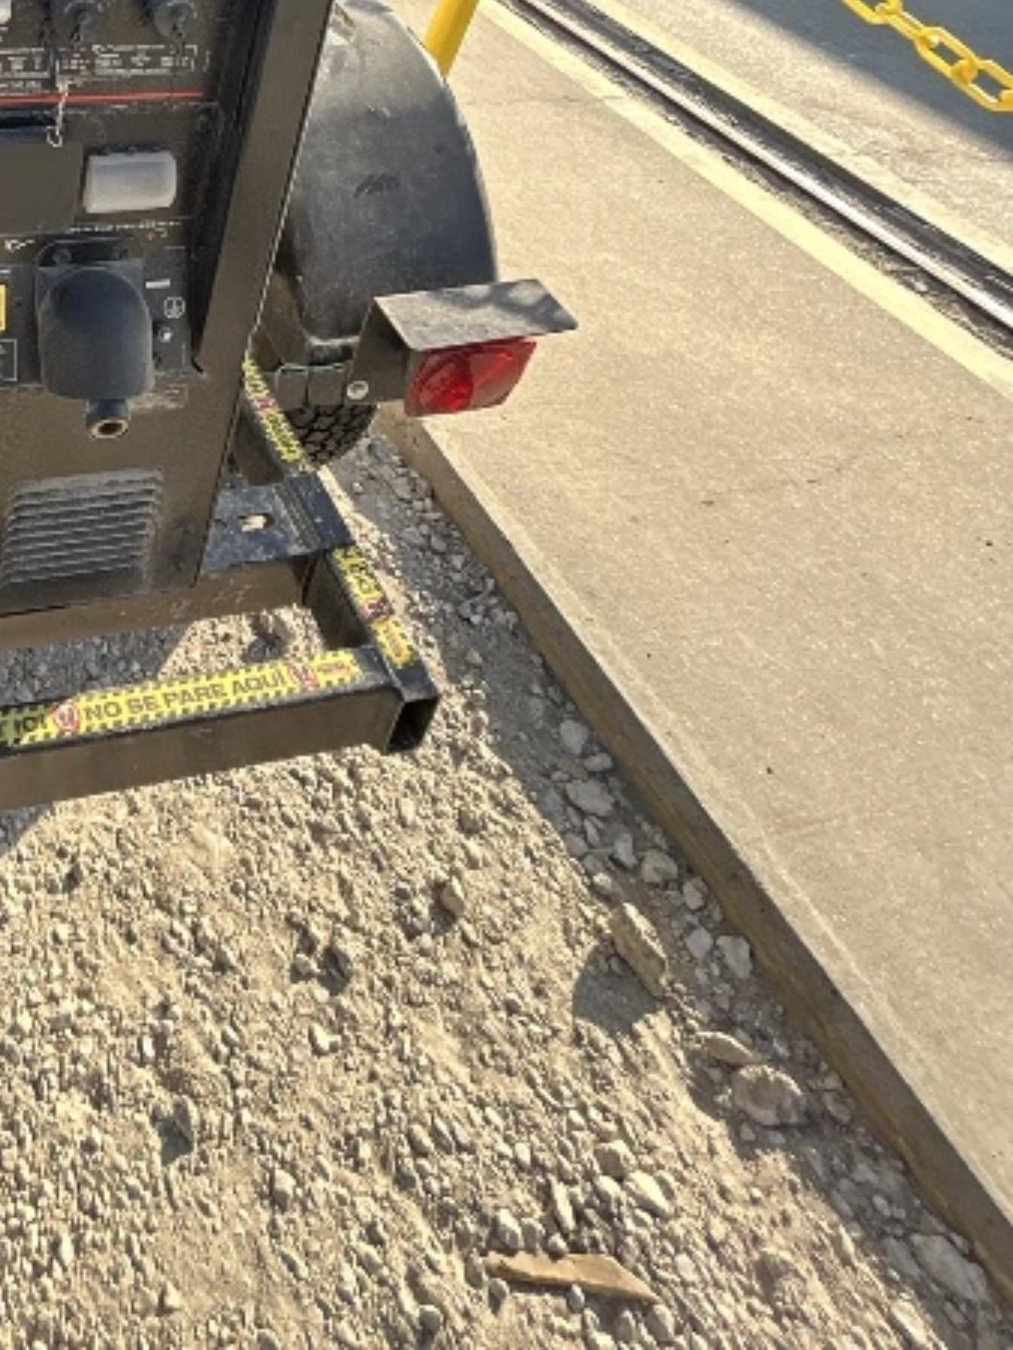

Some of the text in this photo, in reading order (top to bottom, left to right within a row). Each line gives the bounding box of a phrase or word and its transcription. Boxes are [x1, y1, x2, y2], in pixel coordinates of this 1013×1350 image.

[83, 700, 124, 723] NO
[126, 692, 161, 715] SE
[164, 682, 229, 710] PARE
